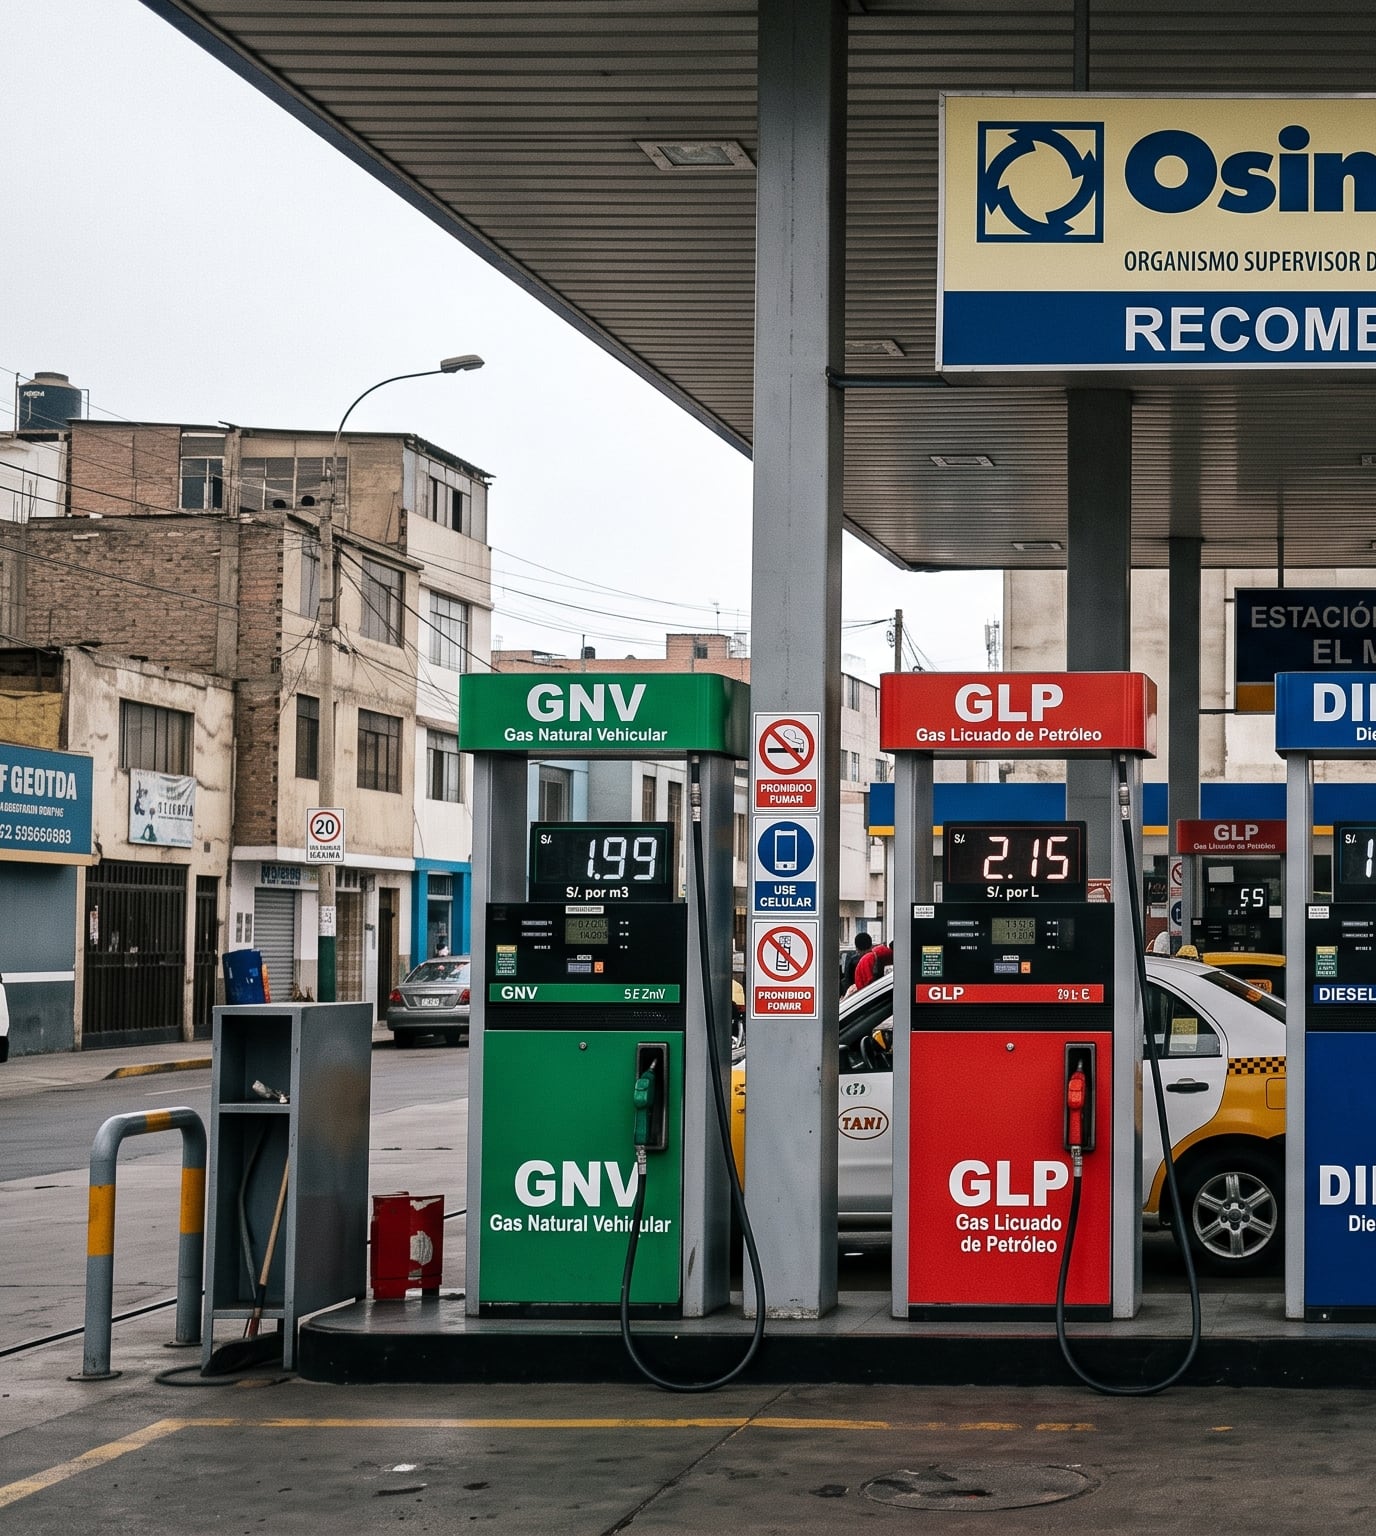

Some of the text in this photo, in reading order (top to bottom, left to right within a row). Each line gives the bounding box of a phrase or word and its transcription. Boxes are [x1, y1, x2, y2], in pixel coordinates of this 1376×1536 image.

[1125, 251, 1238, 271] ORGANISMO
[1245, 251, 1360, 271] SUPERVISOR
[1314, 640, 1352, 663] EL
[527, 684, 646, 722] GNV
[955, 684, 1063, 722] GLP
[505, 728, 667, 741] Gas Natural Vehicular
[917, 728, 1101, 741] Gas Licuado de Petróleo
[11, 765, 77, 800] GEOTDA
[315, 820, 335, 835] 20
[1214, 825, 1258, 840] GLP
[587, 837, 657, 880] 1.99
[983, 837, 1068, 879] 2.15
[567, 887, 628, 900] S/. por m3
[774, 886, 796, 894] USE
[987, 886, 1039, 901] S/. por L
[760, 898, 811, 907] CELULAR
[502, 986, 538, 999] GNV
[929, 987, 963, 1000] GLP
[1320, 988, 1376, 1000] DIESEL
[842, 1117, 883, 1130] TANI
[514, 1160, 640, 1207] GNV
[949, 1160, 1068, 1207] GLP
[490, 1215, 671, 1232] Gas Natural Vehiular
[956, 1214, 1061, 1230] Gas Licuado
[961, 1236, 1057, 1252] de Petróleo
